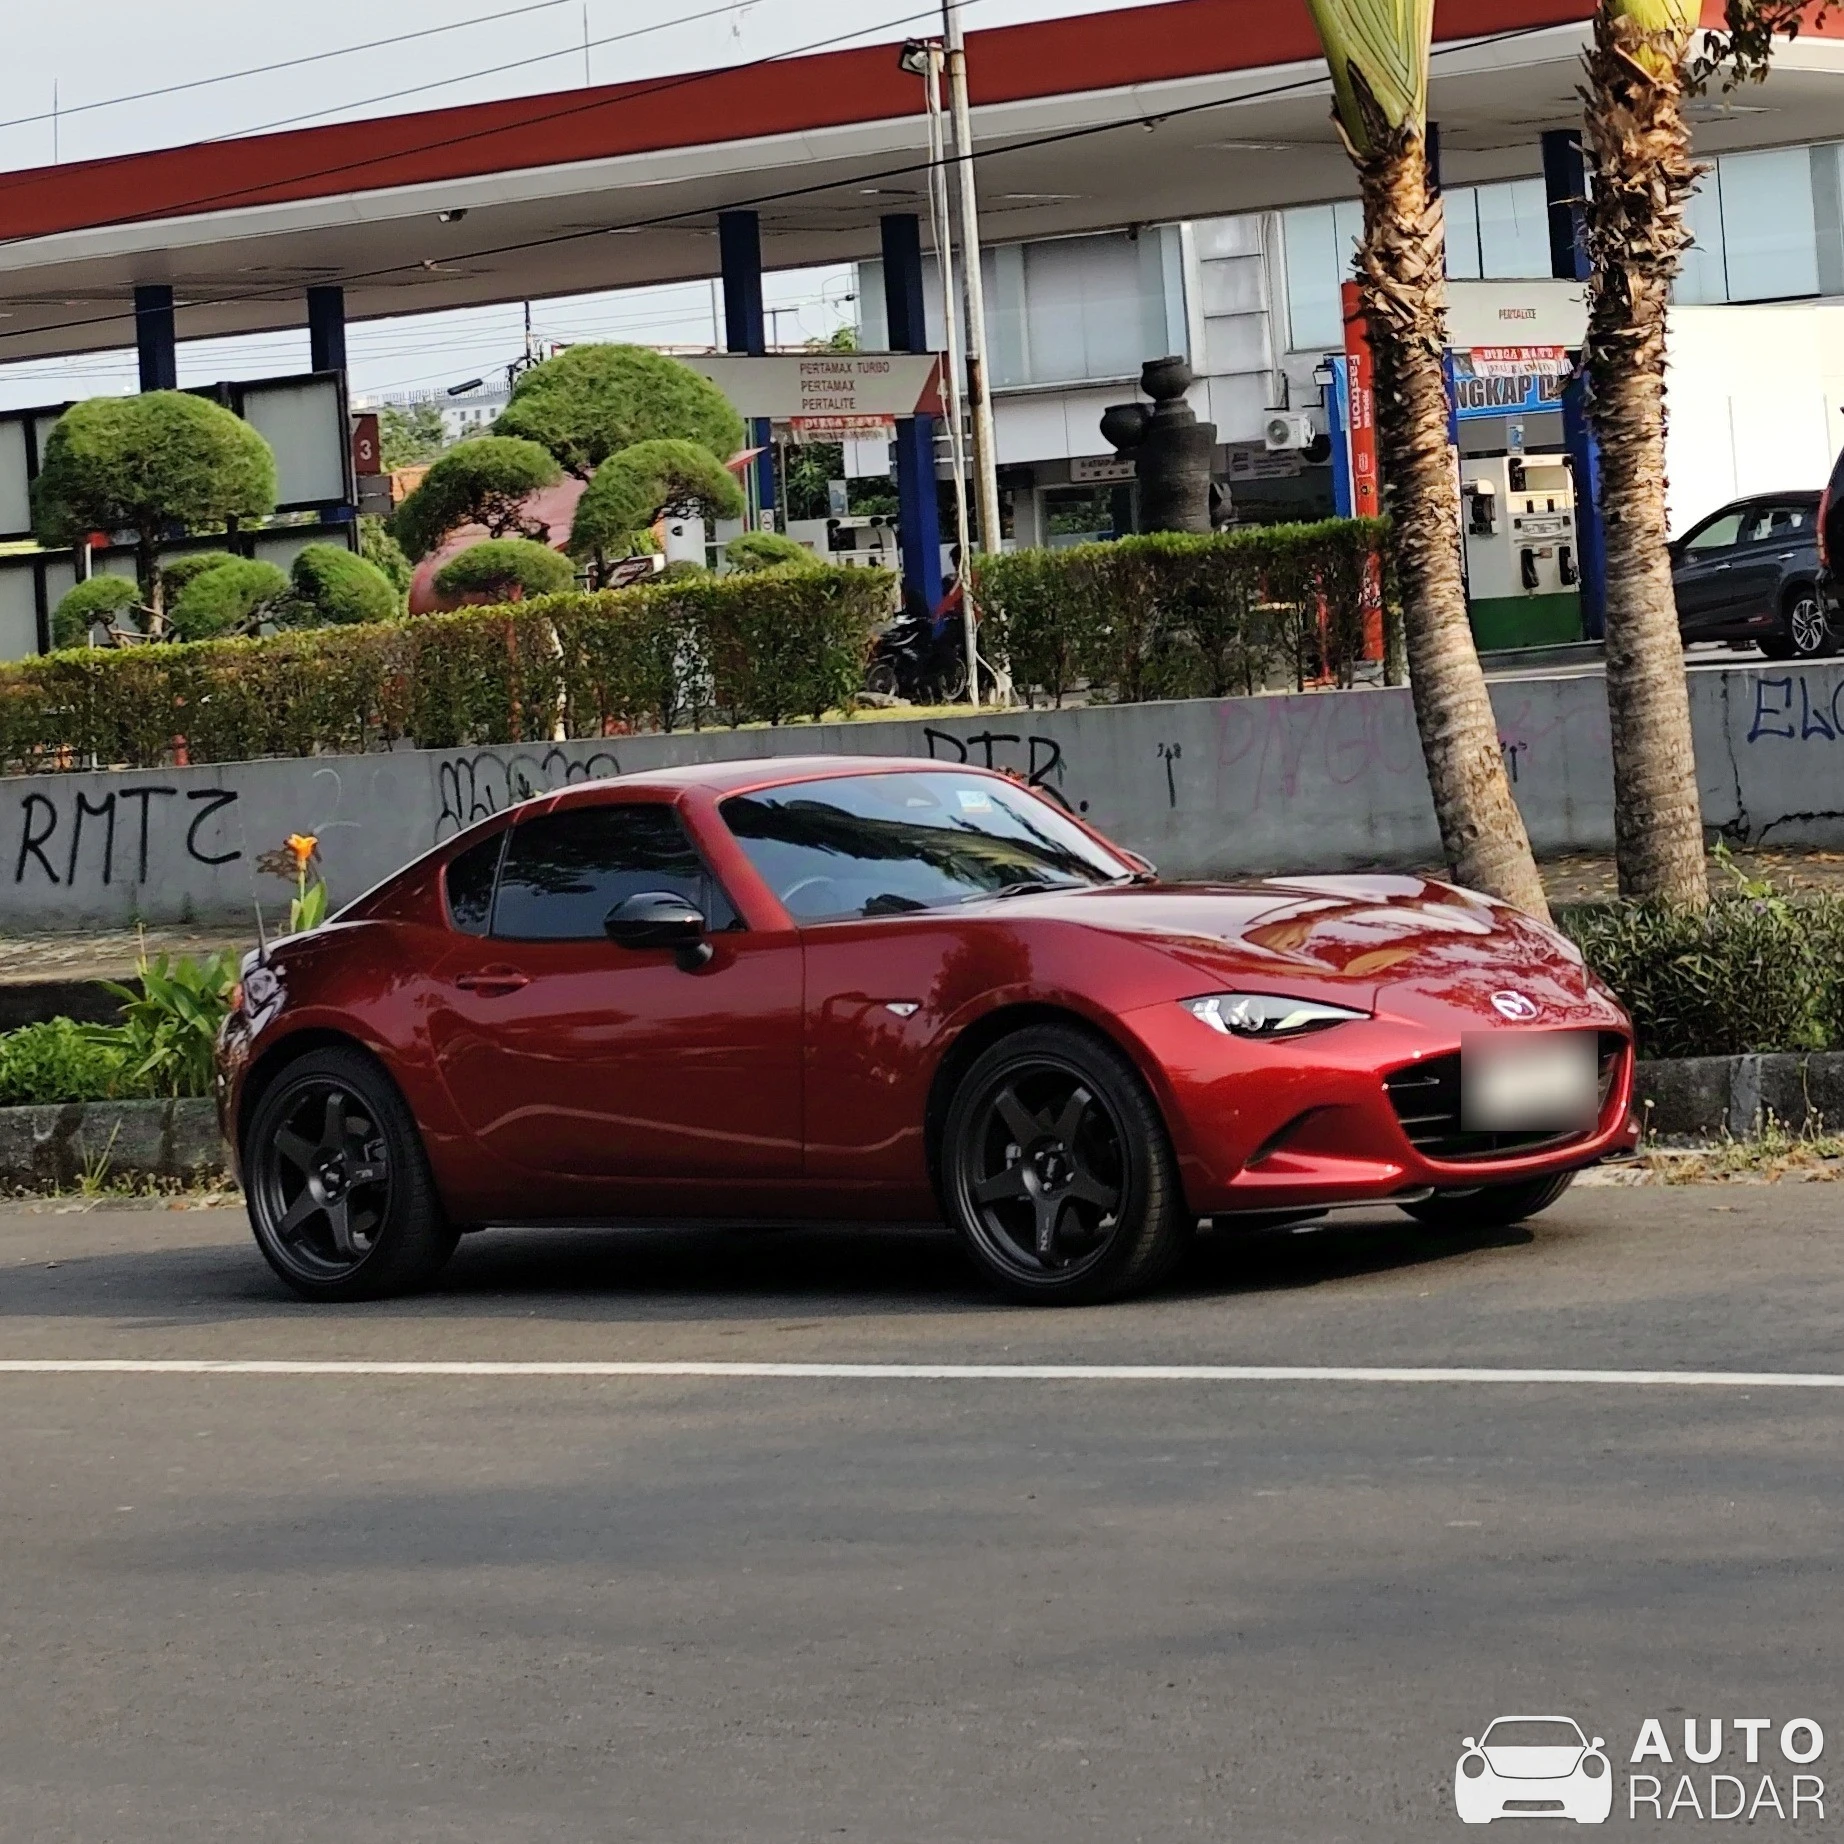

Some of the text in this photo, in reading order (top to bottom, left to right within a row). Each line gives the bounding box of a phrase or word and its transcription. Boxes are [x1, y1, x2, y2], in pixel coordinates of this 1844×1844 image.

[800, 361, 890, 375] PERTAMAX TURBO
[801, 380, 855, 393] PERTAMAX
[1349, 354, 1362, 430] Fastron
[802, 397, 856, 410] PERTALITE
[360, 439, 371, 460] 3
